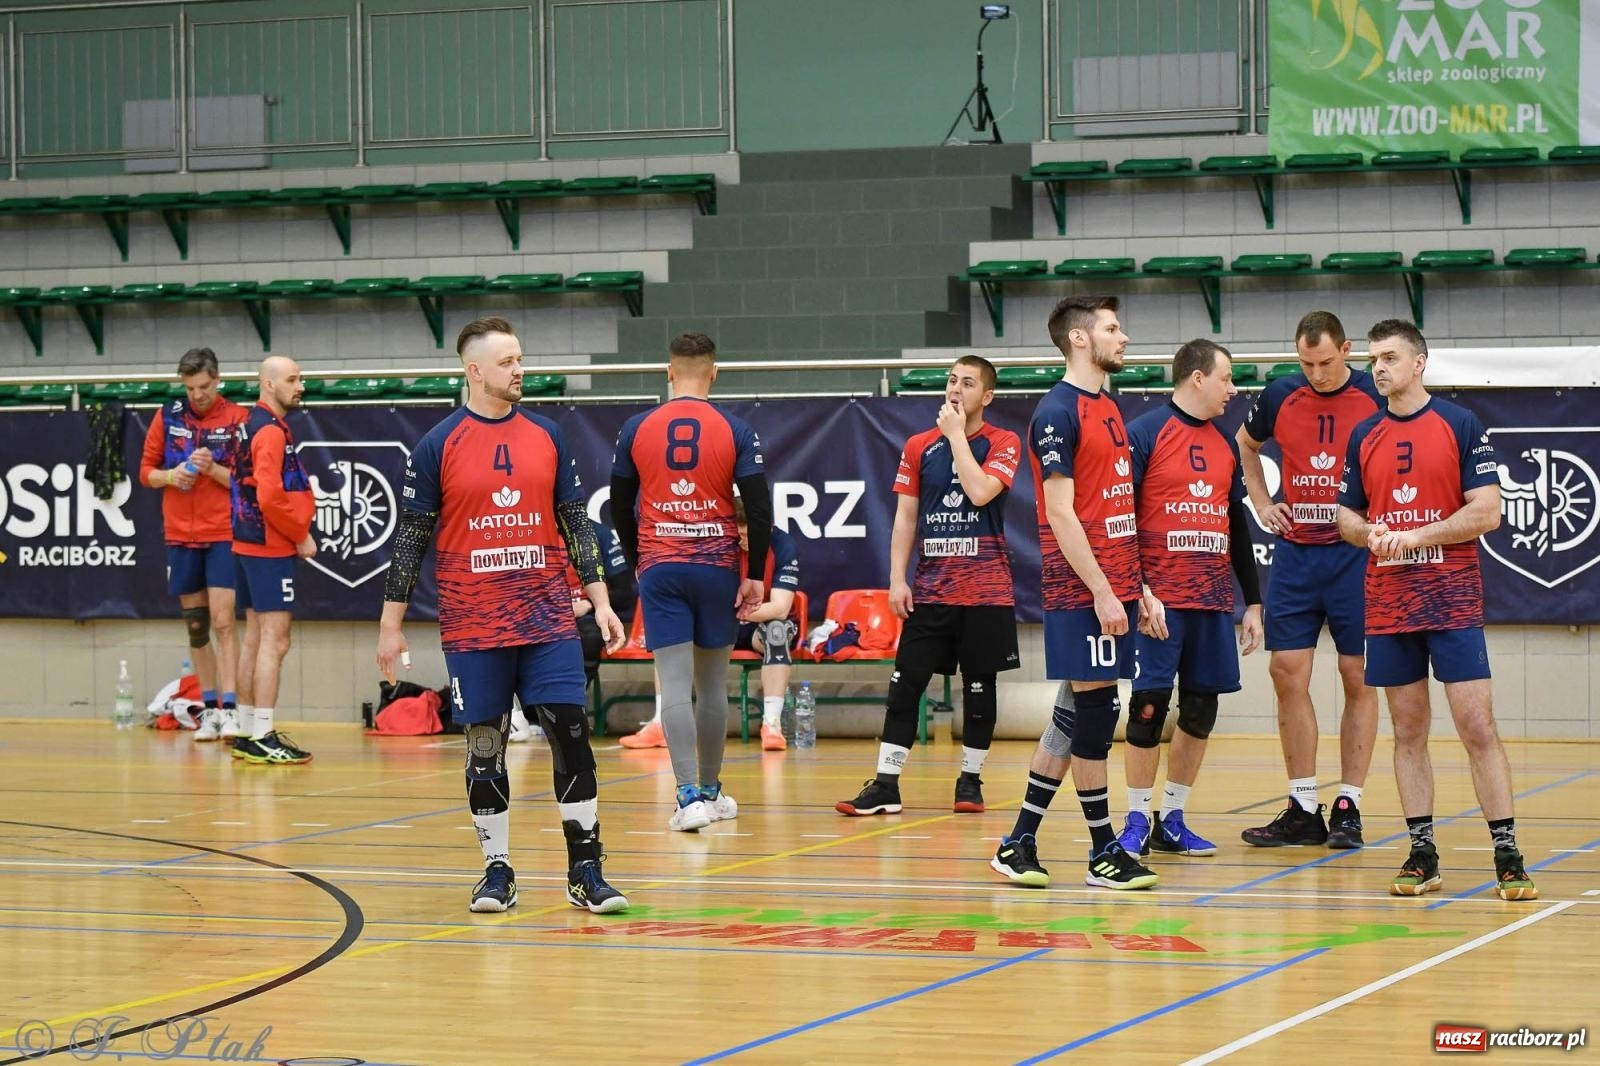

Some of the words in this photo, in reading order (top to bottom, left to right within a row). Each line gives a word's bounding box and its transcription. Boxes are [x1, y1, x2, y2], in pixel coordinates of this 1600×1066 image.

[1386, 10, 1546, 63] MAR
[1387, 68, 1433, 84] sklep
[1441, 65, 1546, 83] zoologiczny
[1312, 103, 1549, 136] WWW.ZOO-MAR.PL
[1317, 414, 1335, 444] 11
[666, 418, 701, 471] 8
[493, 444, 513, 476] 4
[1189, 445, 1207, 472] 6
[1396, 441, 1413, 475] 3
[1102, 483, 1134, 500] KATO
[1292, 475, 1342, 487] KATOL
[1301, 489, 1335, 497] GROU
[0, 463, 136, 538] SiR
[1165, 502, 1229, 518] KATOLIK
[926, 511, 980, 524] KATOLIK
[1180, 516, 1222, 525] GROUP
[1294, 504, 1337, 523] nowiny
[483, 529, 533, 541] GROUP
[925, 539, 976, 555] nowiny.pl
[19, 539, 136, 566] RACIBÓRZ
[473, 547, 544, 569] nowiny.pl
[281, 578, 295, 602] 5
[1087, 635, 1116, 667] 10
[452, 677, 464, 710] 4
